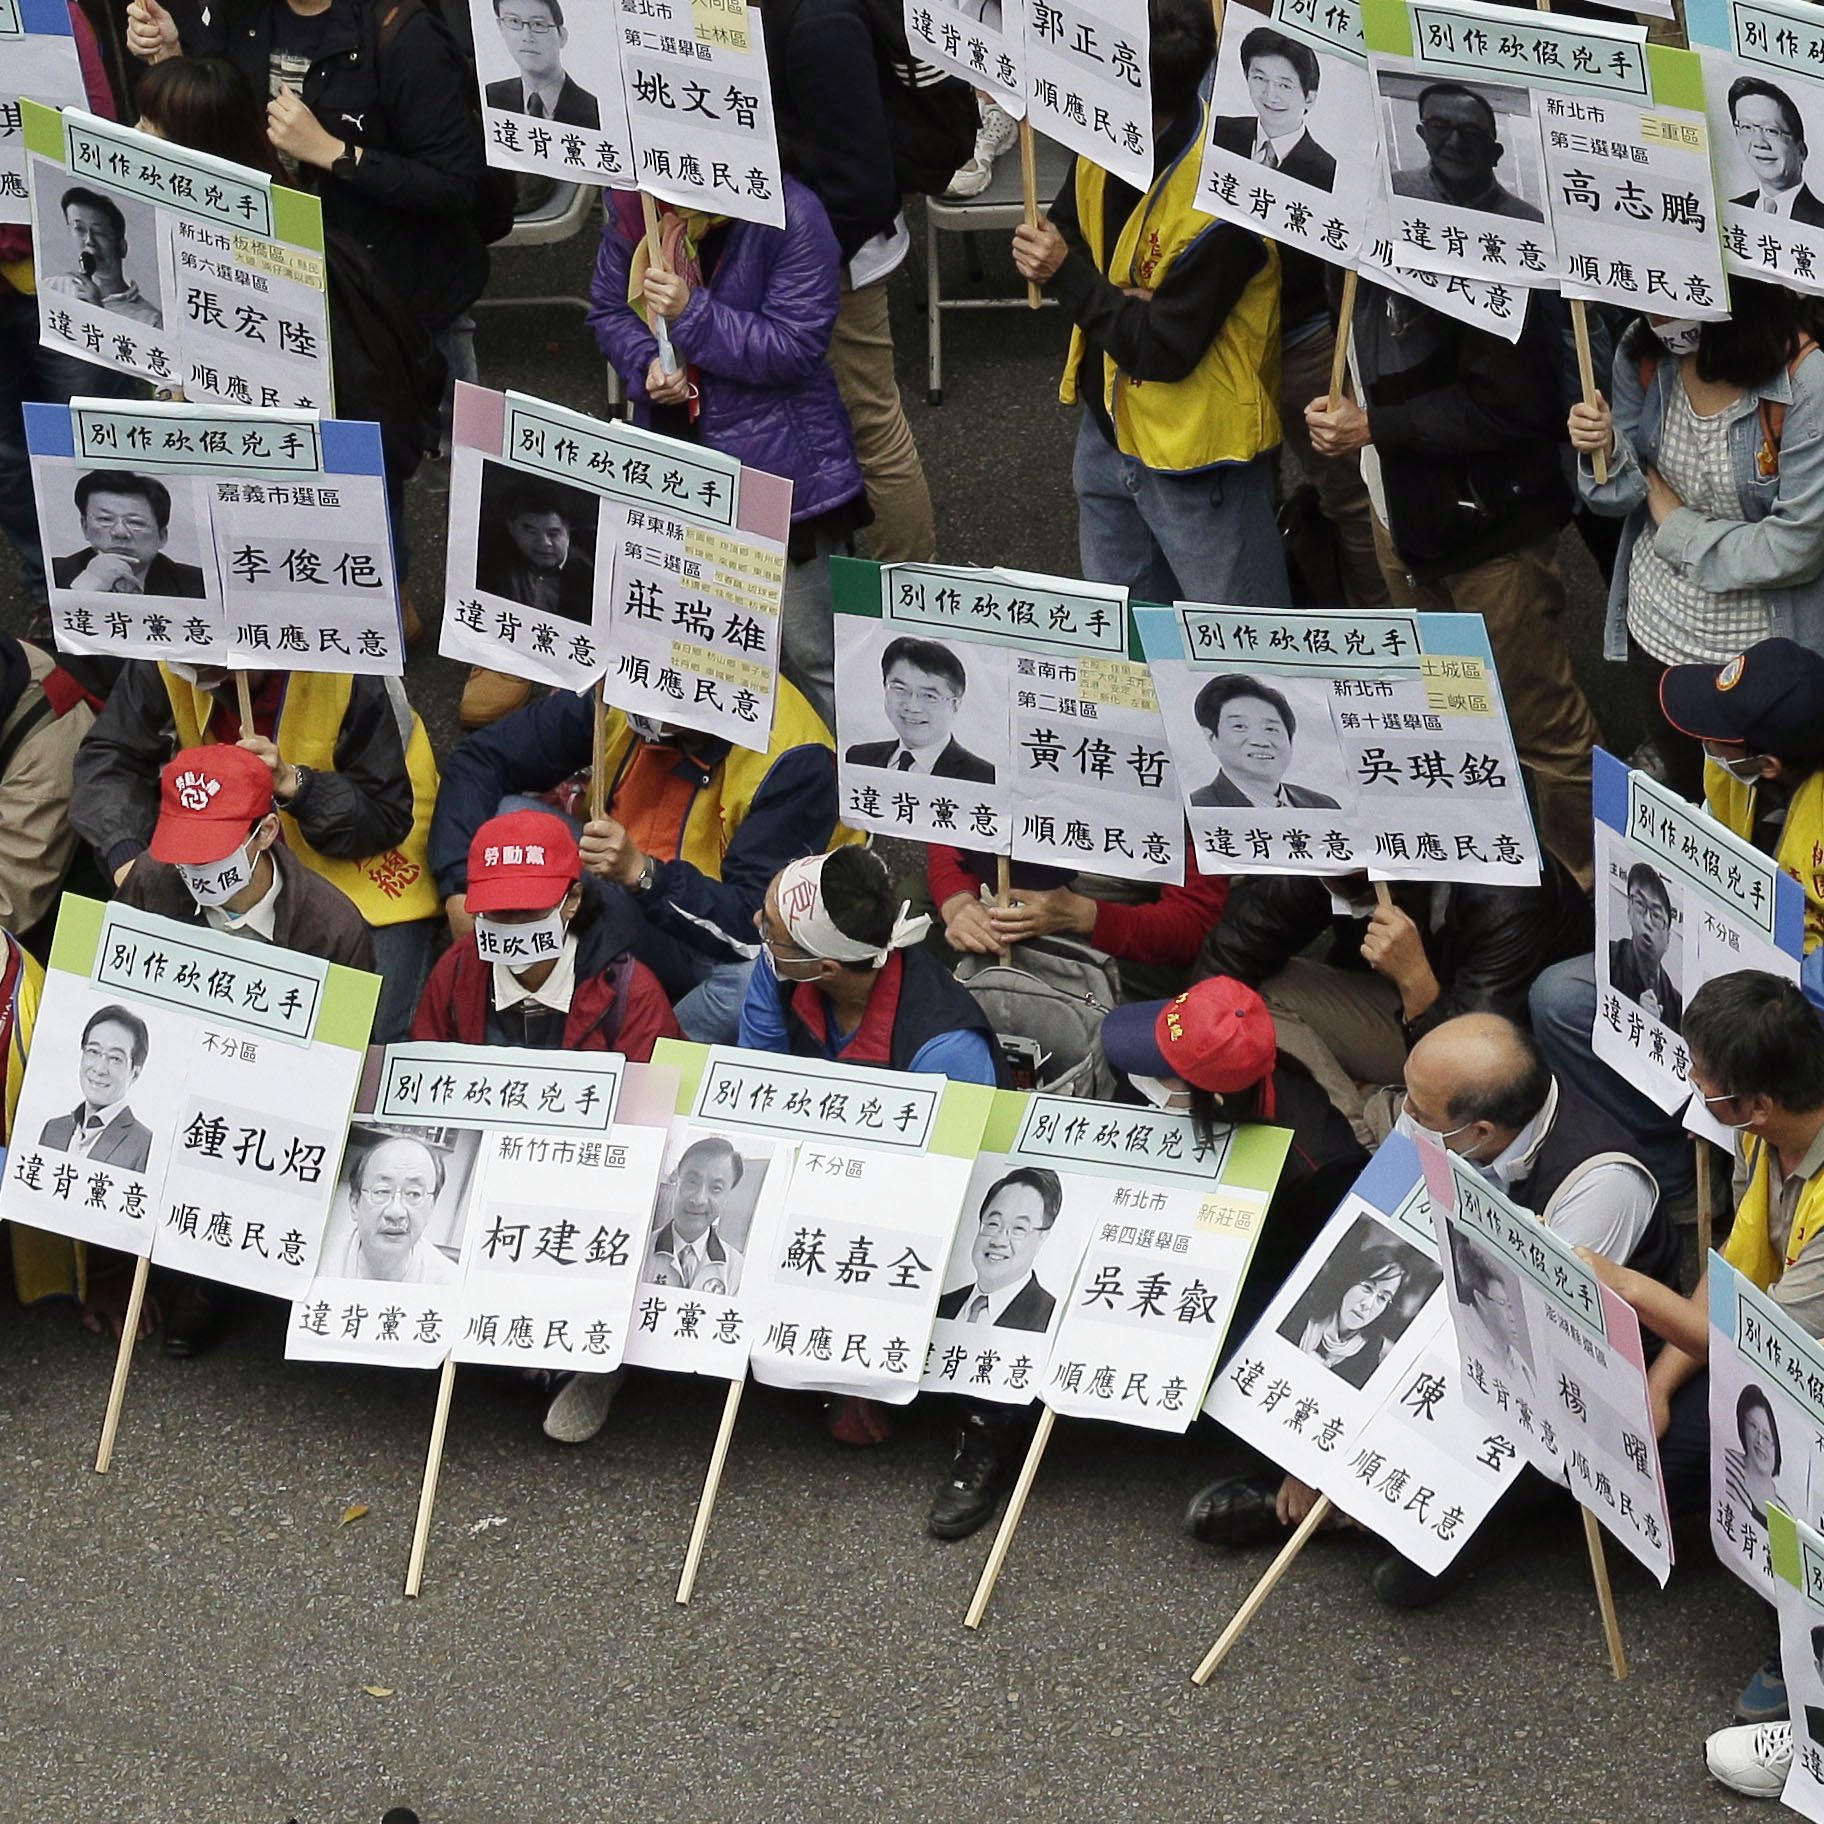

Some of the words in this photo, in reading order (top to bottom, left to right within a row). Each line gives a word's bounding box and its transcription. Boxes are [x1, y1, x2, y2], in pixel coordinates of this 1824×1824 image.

[623, 27, 712, 61] 第二選舉區
[911, 8, 1017, 87] 違背黨意
[632, 68, 760, 129] 姚文智
[492, 120, 621, 173] 違背黨意
[1550, 132, 1649, 165] 第三選舉區
[1206, 173, 1350, 251] 違背黨意
[1562, 170, 1705, 232] 高志鵬
[179, 249, 271, 292] 第六選舉區
[48, 309, 171, 379] 違背黨意
[185, 286, 317, 361] 張宏陸
[216, 481, 340, 509] 嘉義市選區
[623, 540, 702, 579] 第三選區
[63, 608, 215, 646] 違背黨意
[625, 579, 767, 652] 莊瑞雄
[1340, 711, 1444, 732] 第十選舉區
[1020, 725, 1171, 787] 黃偉哲
[1358, 749, 1508, 790] 吳琪銘
[849, 784, 1000, 836] 違背黨意
[484, 844, 546, 867] 勞動黨
[1637, 804, 1767, 907] 別作砍假兇手
[478, 927, 557, 959] 拒砍假
[200, 1031, 258, 1062] 不分區
[397, 1073, 601, 1112] 別作砍假兇手
[481, 1214, 630, 1269] 柯建銘
[779, 1224, 934, 1291] 蘇嘉全
[1098, 1223, 1190, 1255] 第四選舉區
[1084, 1264, 1218, 1327] 吳秉叡
[762, 1322, 910, 1373] 順應民意
[1229, 1360, 1347, 1452] 違背黨意
[1467, 1357, 1558, 1455] 違背黨意
